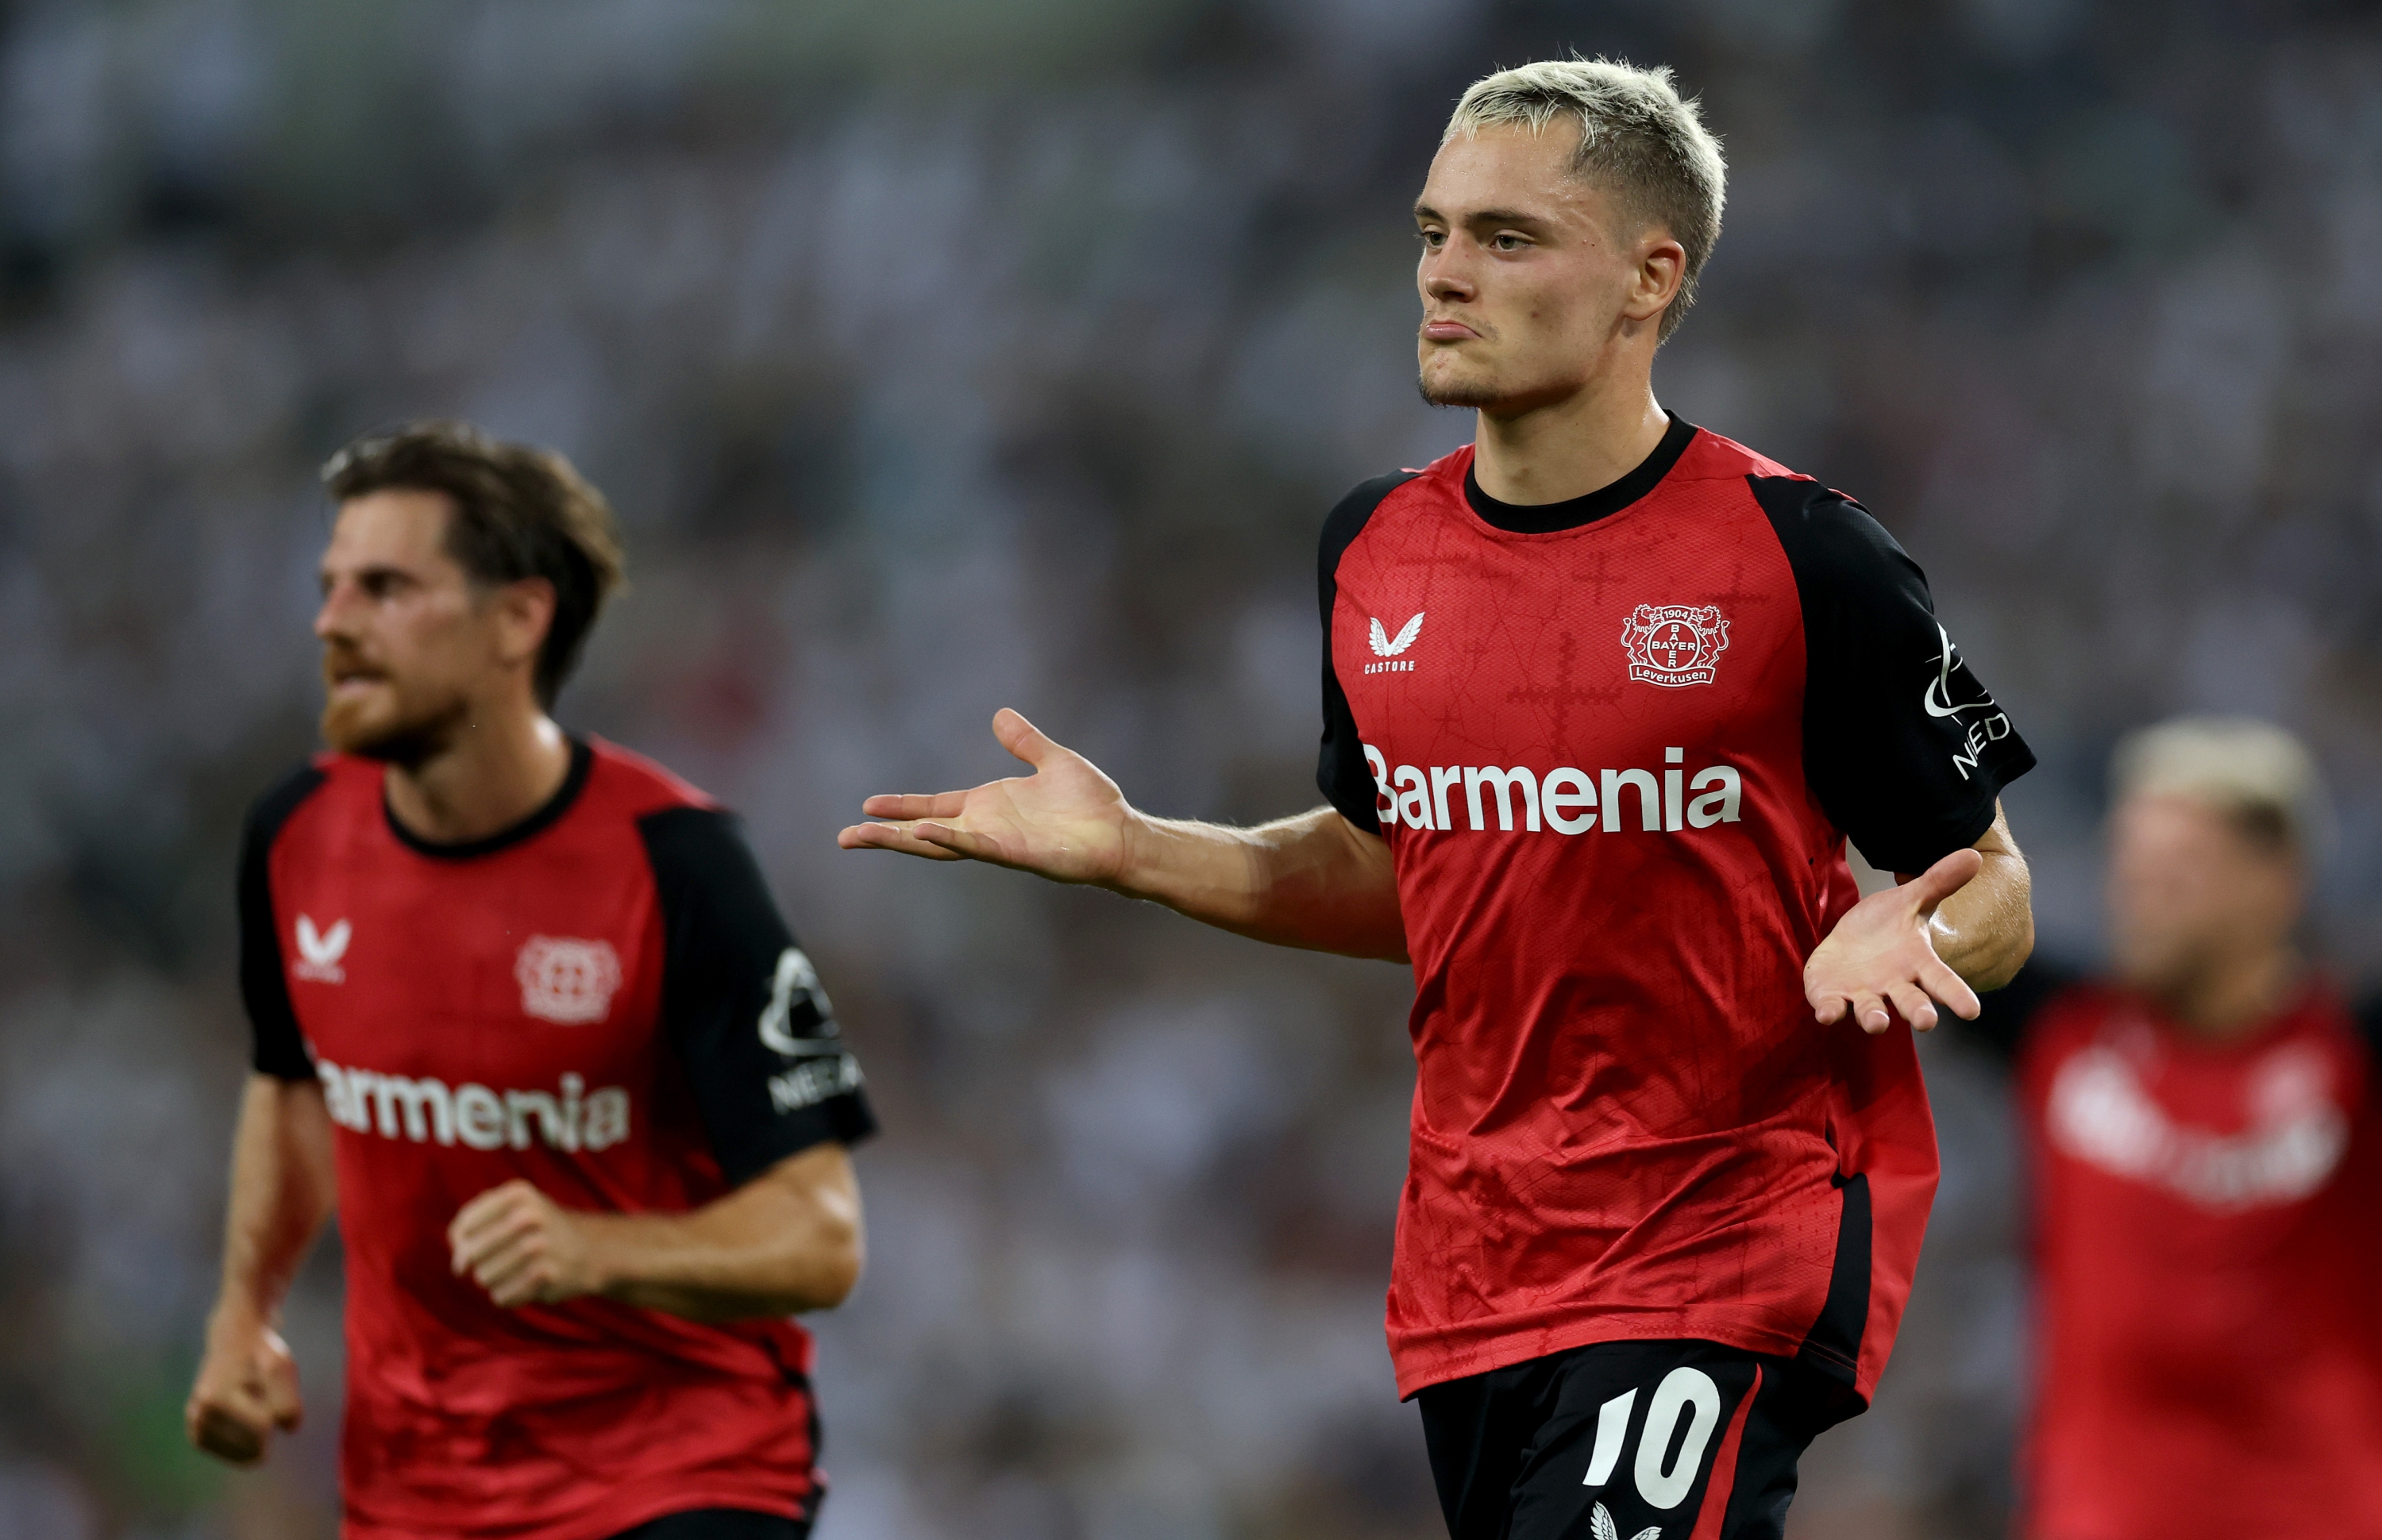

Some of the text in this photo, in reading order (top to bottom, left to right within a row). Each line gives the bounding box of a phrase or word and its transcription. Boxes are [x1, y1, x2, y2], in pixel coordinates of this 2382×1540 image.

[1663, 609, 1689, 619] 1904
[1652, 641, 1696, 651] BAYER
[1364, 660, 1415, 675] CASTORE
[1636, 666, 1707, 683] Leverkusen
[304, 1041, 631, 1153] armenia
[1582, 1366, 1721, 1510] 10
